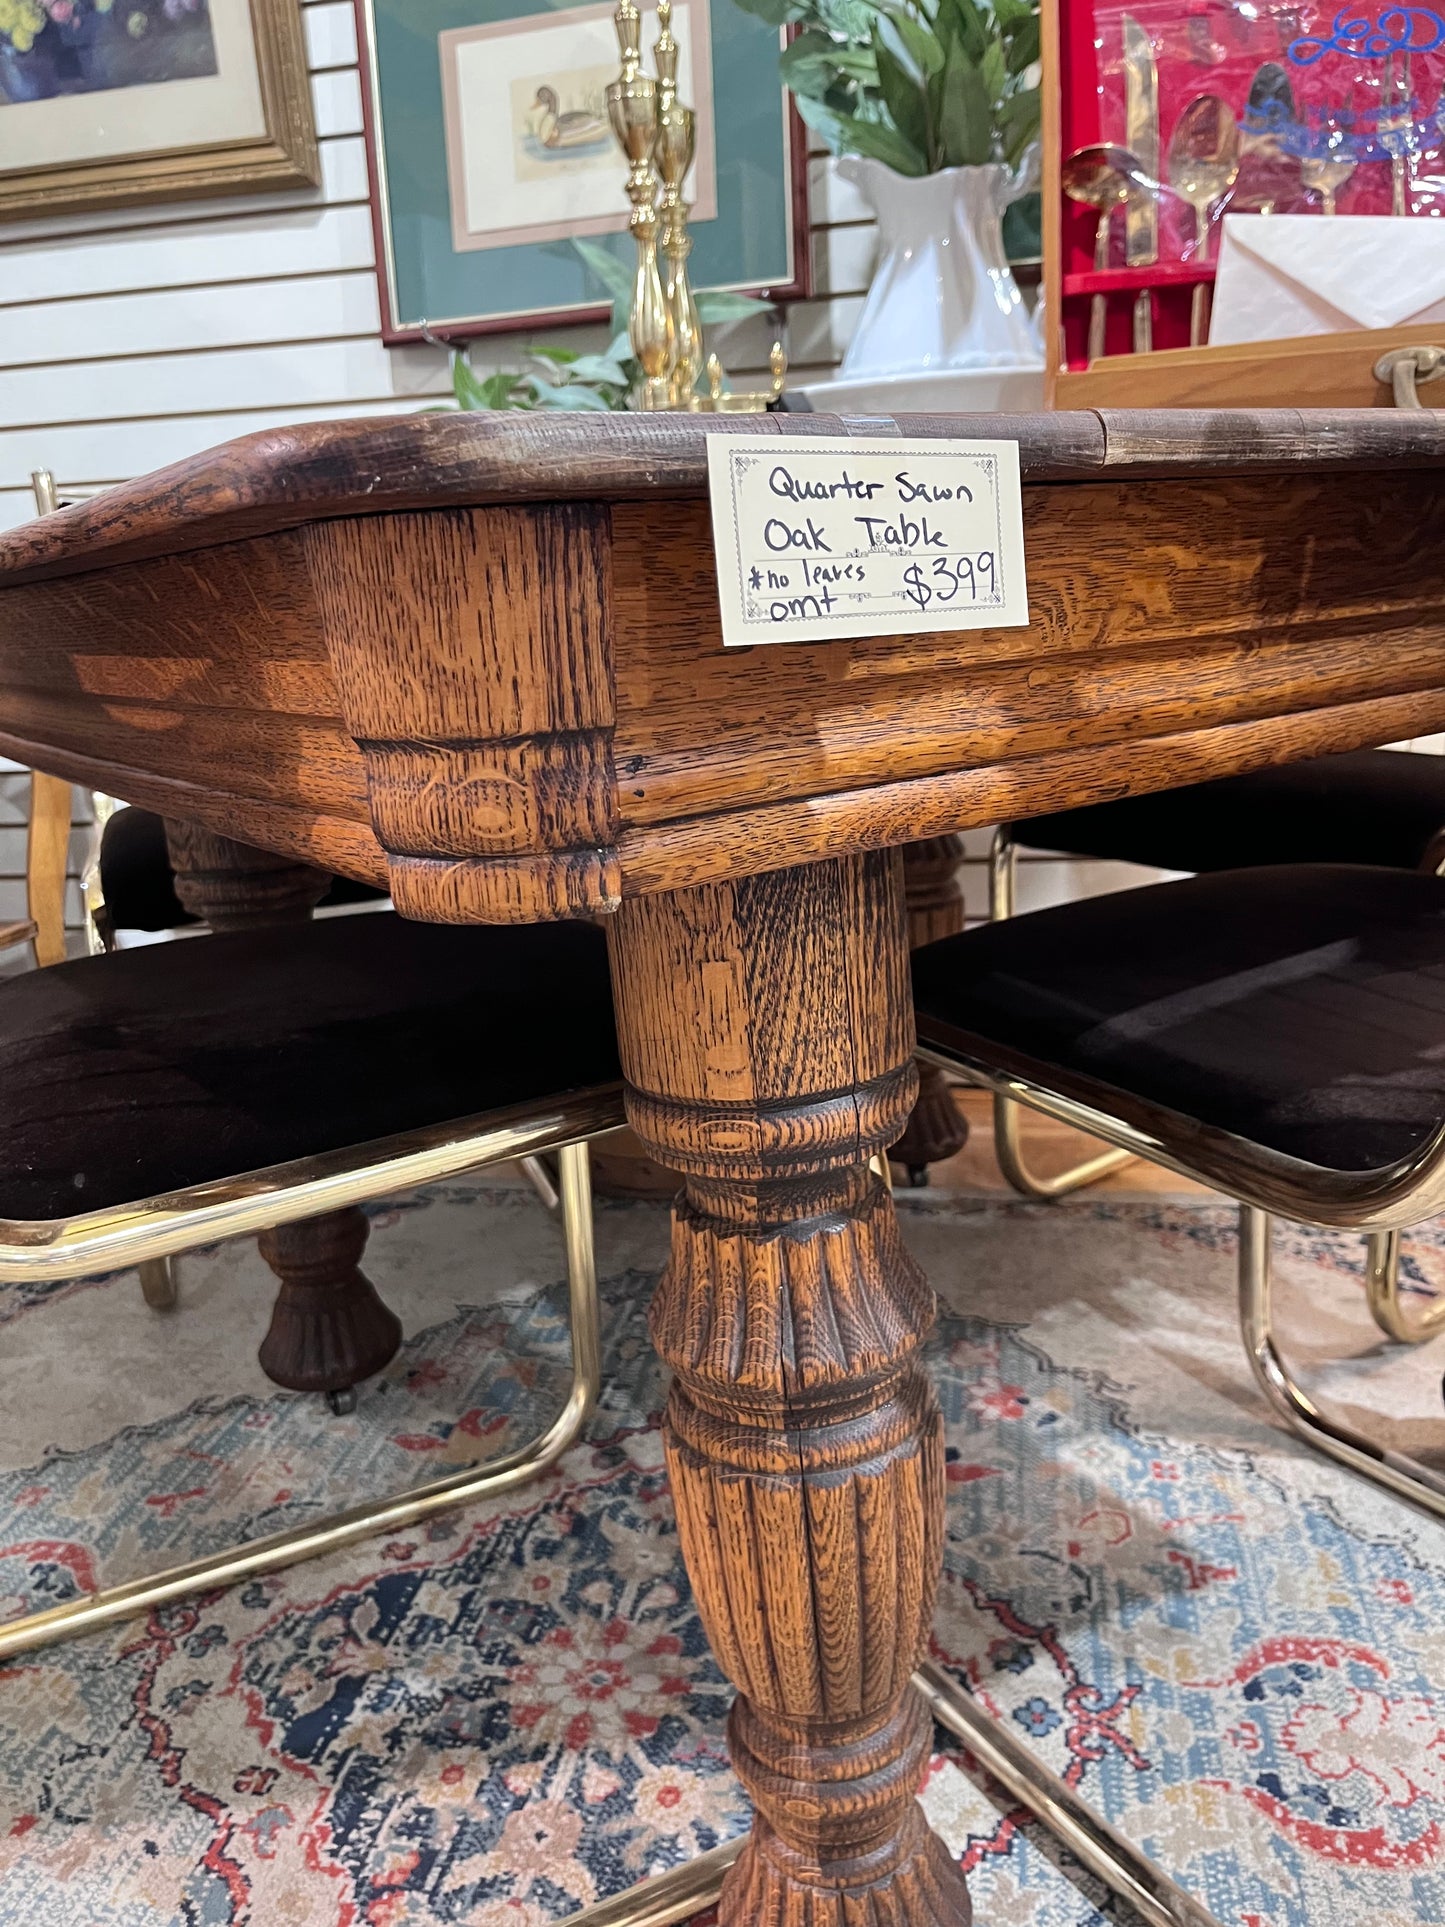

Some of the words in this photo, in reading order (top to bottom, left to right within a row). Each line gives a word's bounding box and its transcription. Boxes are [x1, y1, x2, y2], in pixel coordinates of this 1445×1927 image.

[769, 466, 884, 503] Quarter
[895, 471, 974, 503] Sawn
[764, 518, 832, 552] Oak
[854, 513, 948, 548] Table
[802, 559, 866, 588] leaves
[903, 551, 995, 611] $399
